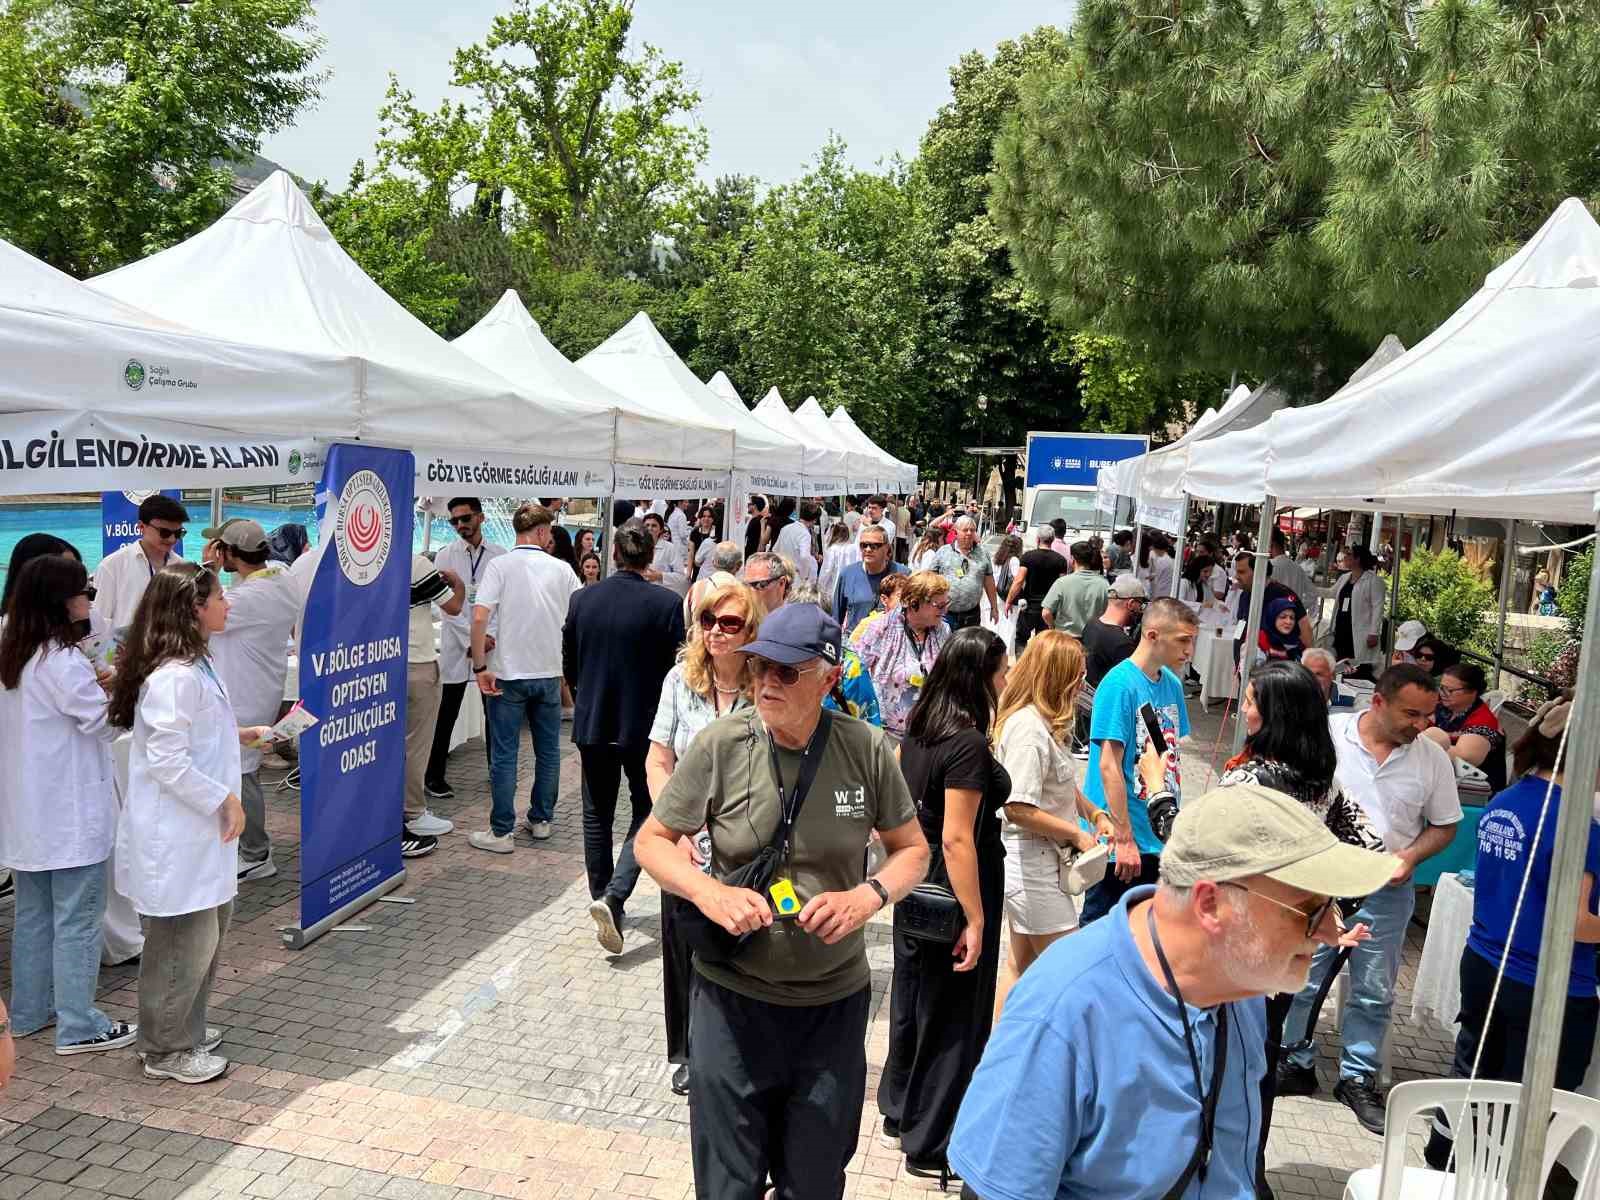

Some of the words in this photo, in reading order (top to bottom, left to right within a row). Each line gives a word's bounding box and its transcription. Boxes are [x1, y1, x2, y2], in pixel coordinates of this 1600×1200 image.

[209, 445, 279, 469] ALANI
[427, 458, 455, 483] GÖZ
[454, 464, 473, 484] VE
[473, 461, 513, 485] GÖRME
[514, 464, 551, 486] SAĞLIĞI
[552, 471, 579, 486] ALANI
[105, 519, 143, 537] V.BÖLG
[311, 642, 365, 677] V.BÖLGE
[367, 636, 401, 665] BURSA
[332, 671, 388, 708] OPTİSYEN
[319, 700, 397, 748] GÖZLÜKÇÜLER
[340, 740, 377, 774] ODASI
[1494, 844, 1502, 858] 11
[1503, 848, 1517, 861] 55
